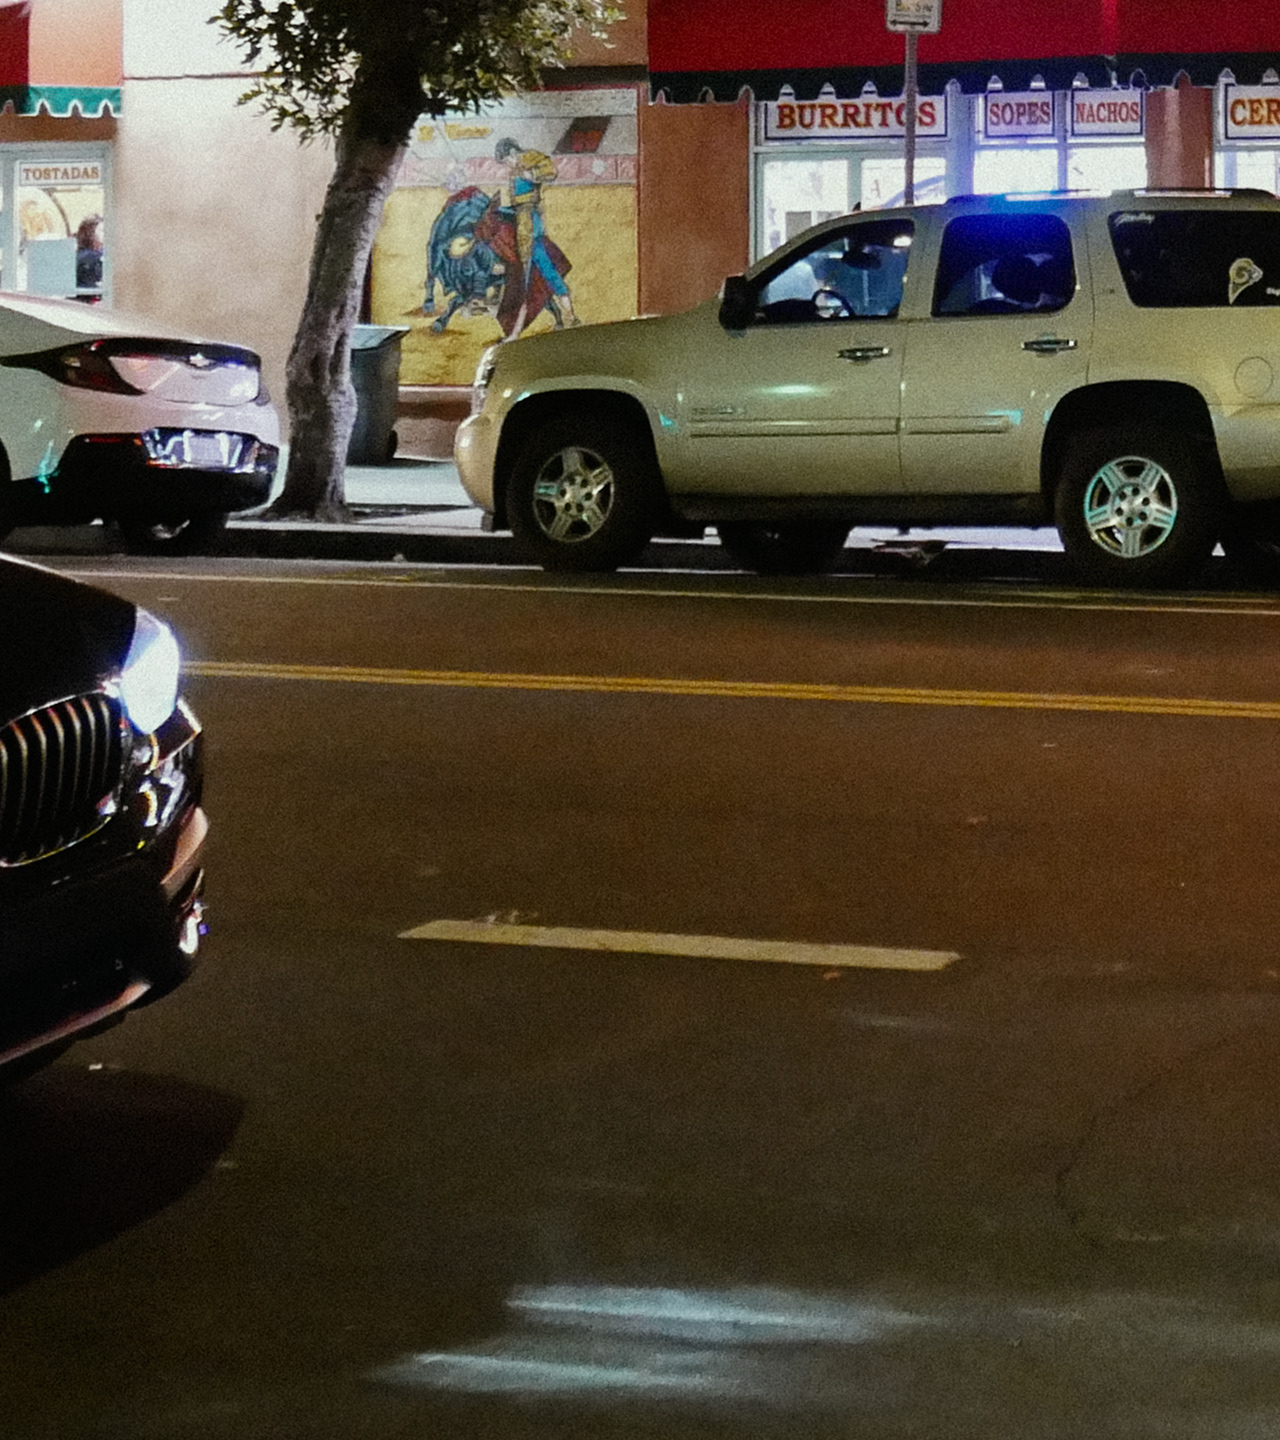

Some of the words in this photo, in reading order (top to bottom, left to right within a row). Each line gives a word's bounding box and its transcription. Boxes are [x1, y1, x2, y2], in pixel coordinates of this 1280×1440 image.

[988, 100, 1051, 126] SOPES
[1074, 100, 1140, 124] NACHOS
[22, 166, 99, 181] TOSTADAS
